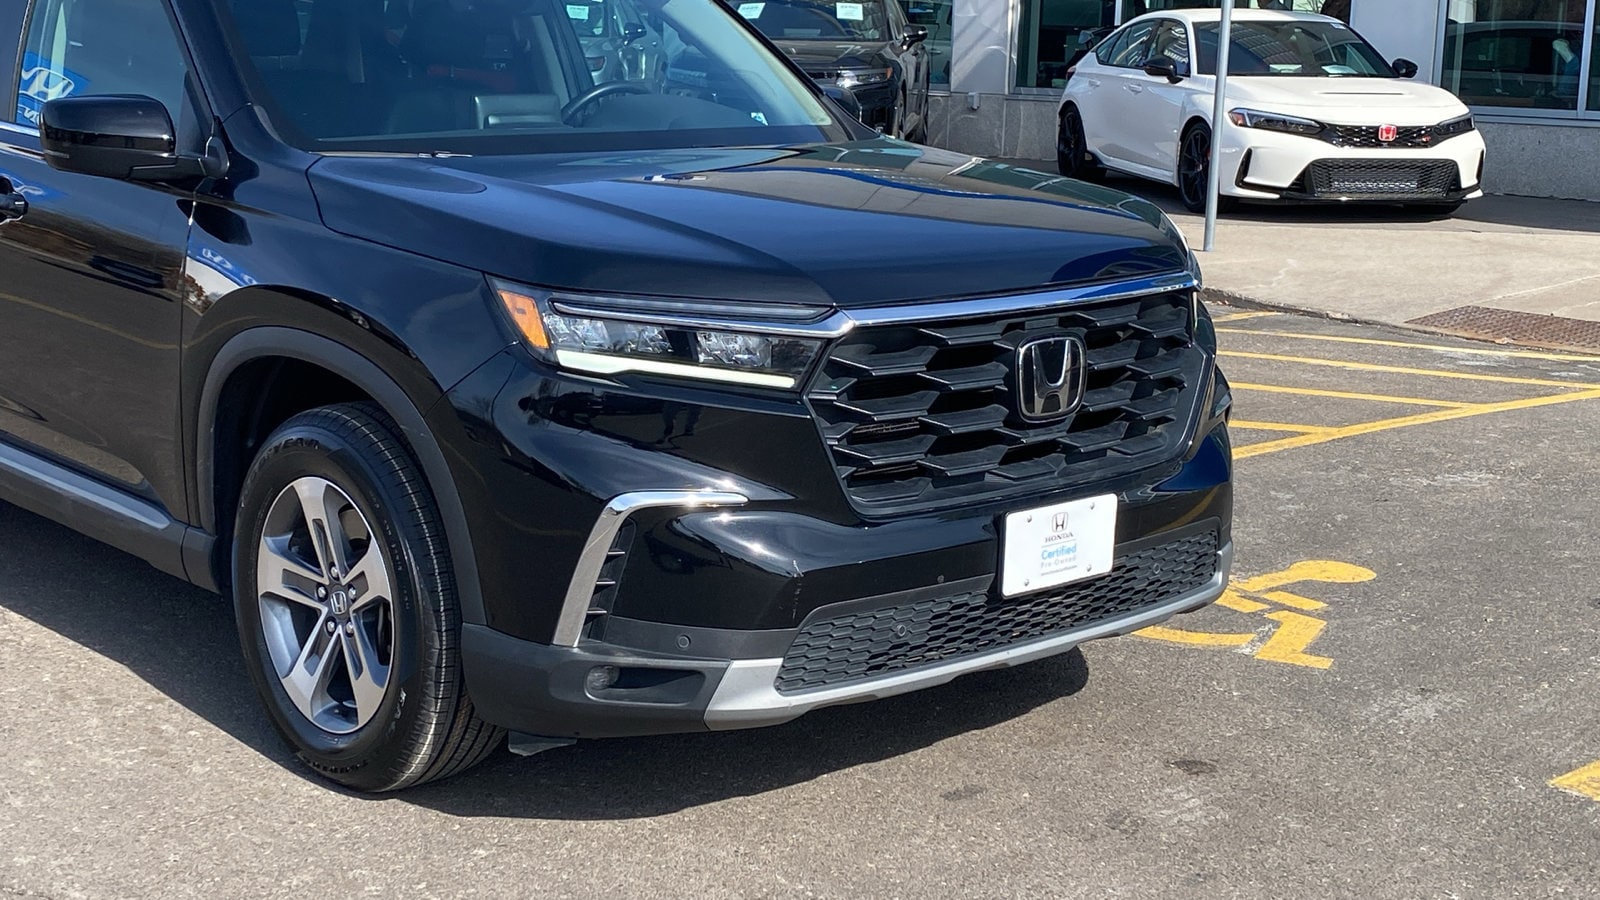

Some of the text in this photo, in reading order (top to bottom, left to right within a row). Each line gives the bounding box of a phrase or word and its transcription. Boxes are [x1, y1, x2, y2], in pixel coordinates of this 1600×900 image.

[1045, 532, 1074, 543] HONDA
[1041, 543, 1077, 560] Certified
[1041, 556, 1077, 568] Pre-Owned
